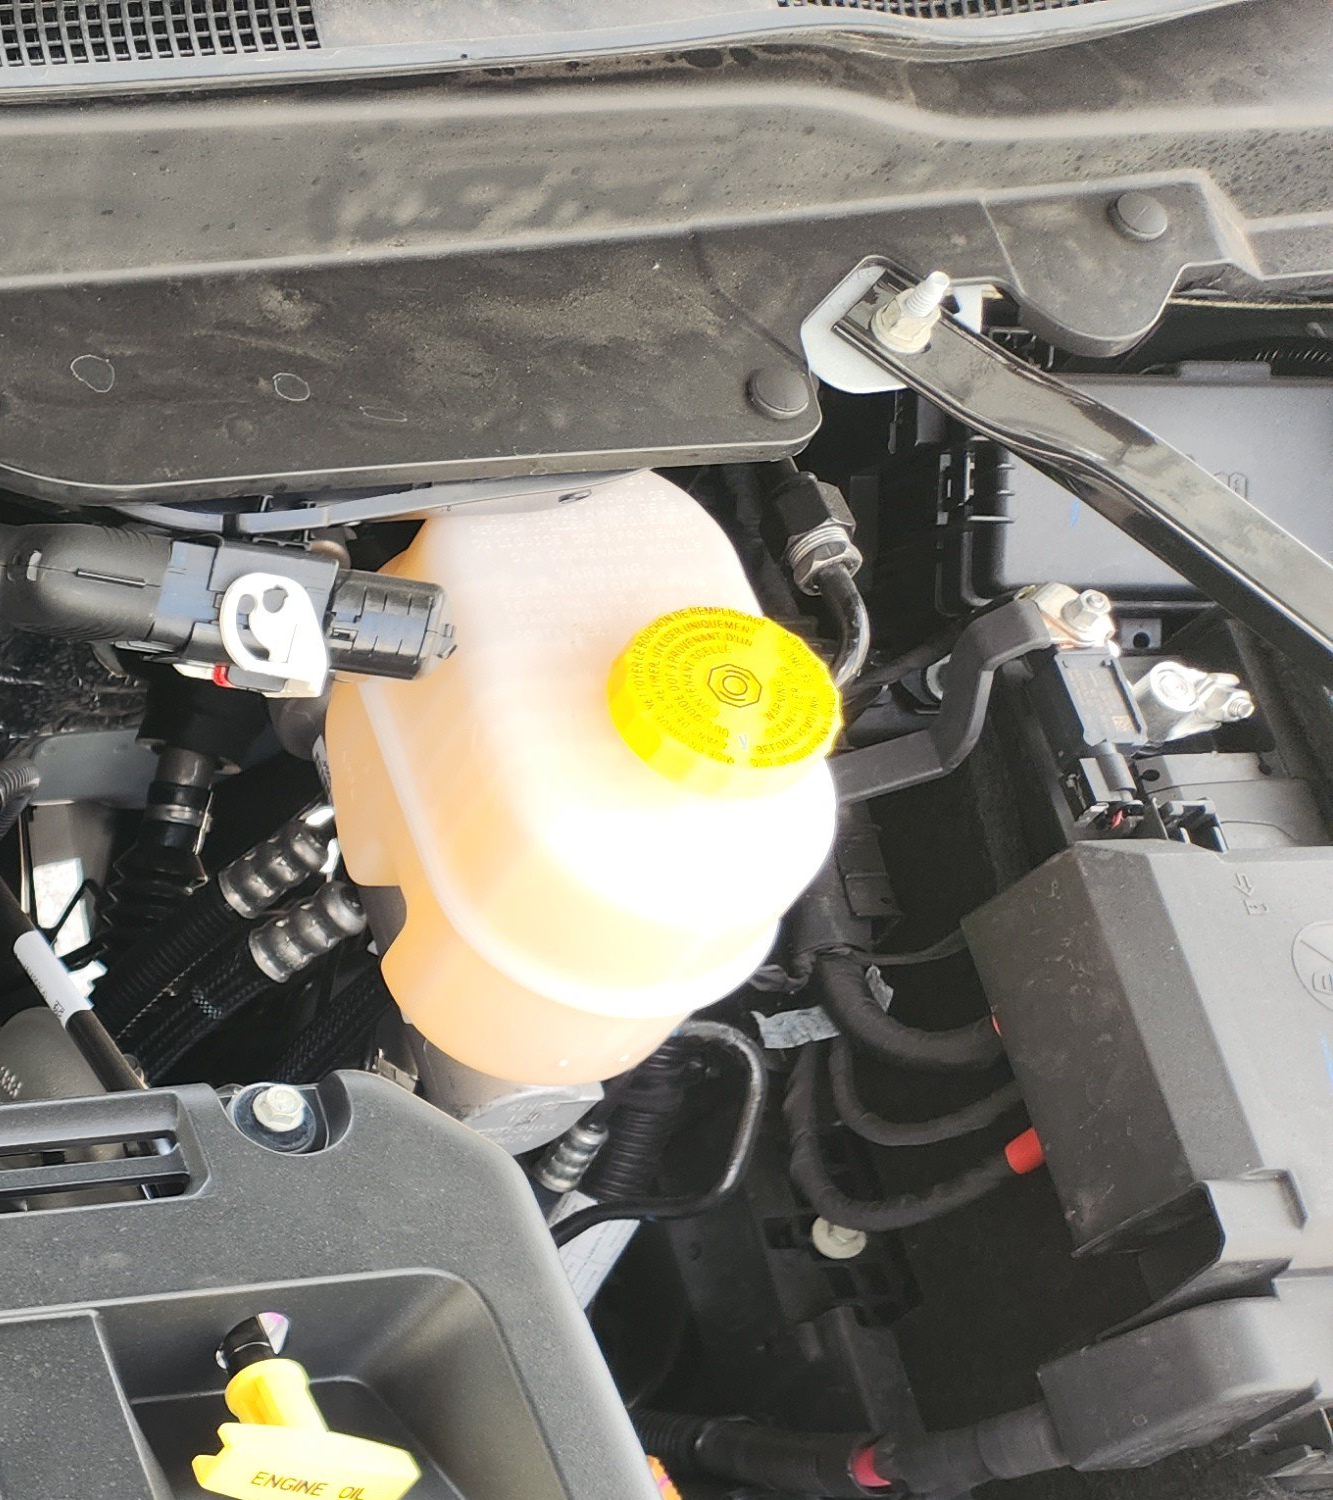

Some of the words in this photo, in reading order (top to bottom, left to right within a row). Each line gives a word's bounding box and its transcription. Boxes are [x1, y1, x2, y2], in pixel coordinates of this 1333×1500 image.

[635, 613, 676, 649] BOUCHON
[671, 608, 690, 621] DE
[687, 605, 769, 628] REMPLISSAGE
[666, 630, 722, 664] PROVENANT
[251, 1471, 329, 1496] ENGINE
[338, 1486, 365, 1500] OIL
